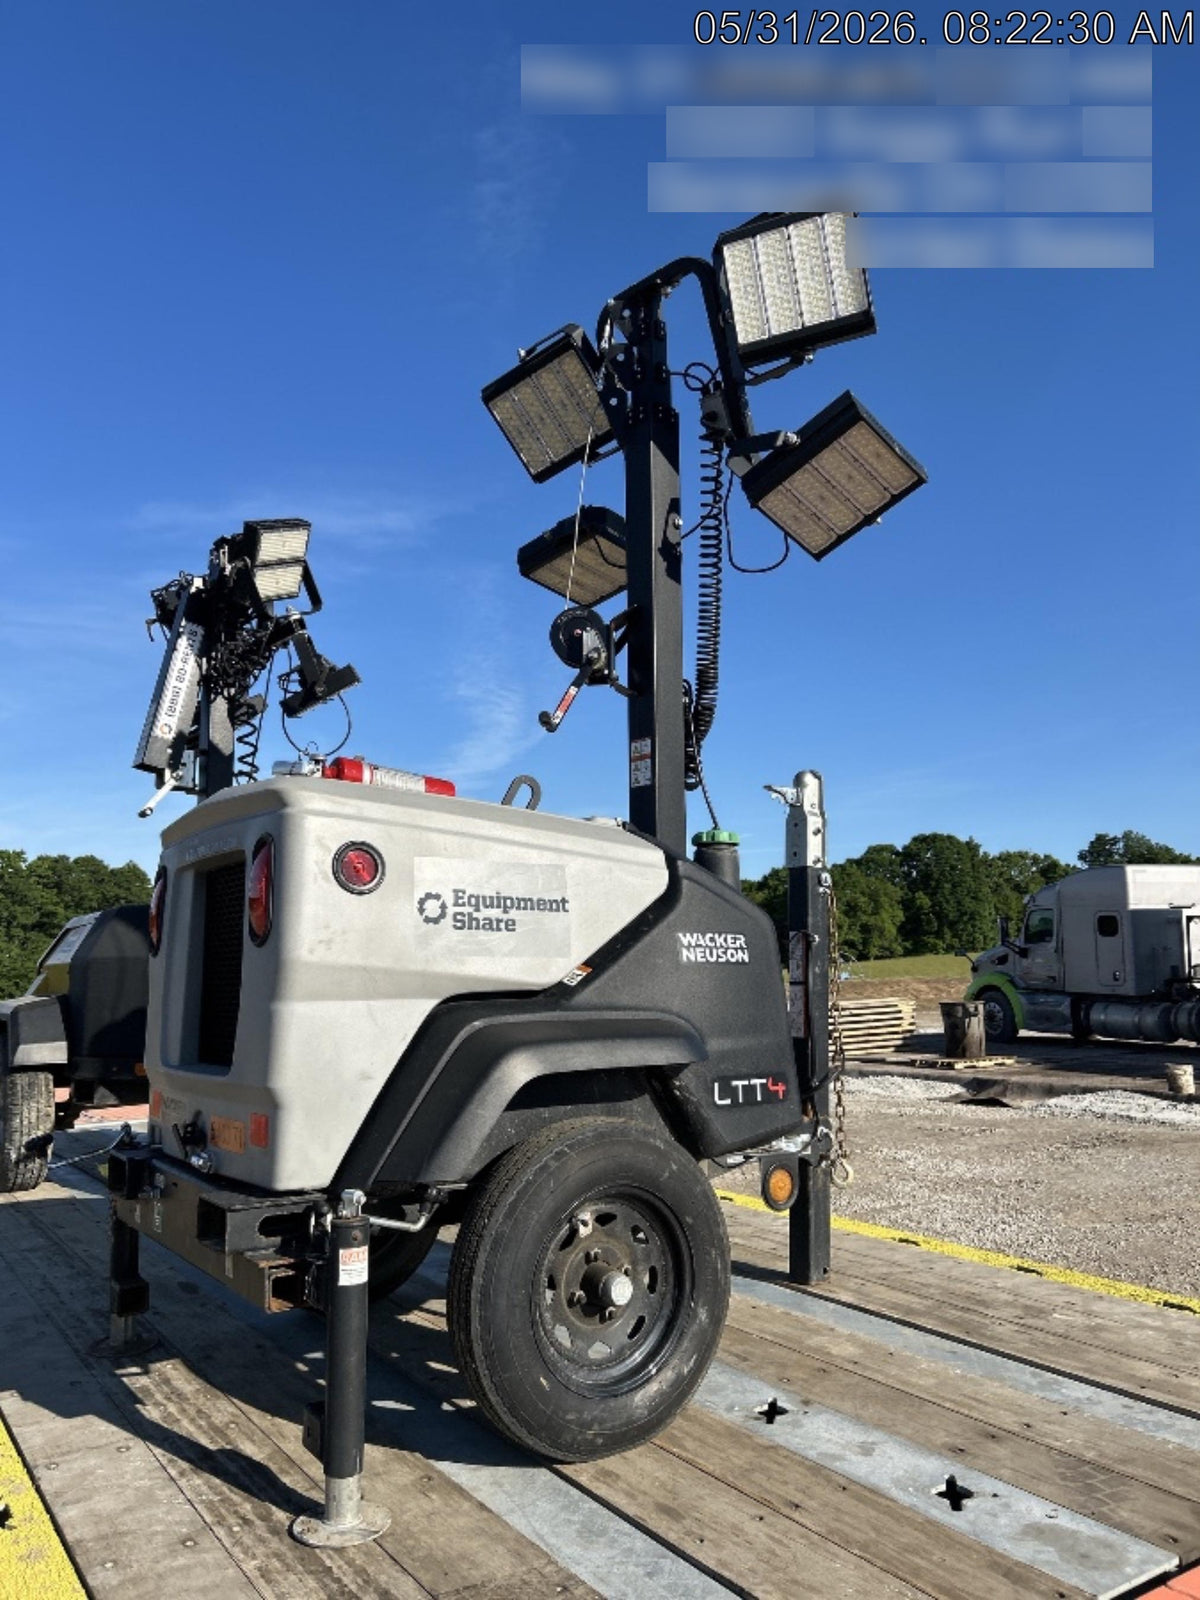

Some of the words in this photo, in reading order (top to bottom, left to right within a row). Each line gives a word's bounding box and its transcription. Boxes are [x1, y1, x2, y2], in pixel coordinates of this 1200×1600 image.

[452, 888, 570, 914] Equipment
[452, 911, 517, 932] Share
[678, 932, 748, 948] WACKER
[681, 947, 750, 963] NEUSON
[714, 1076, 787, 1105] LTT4
